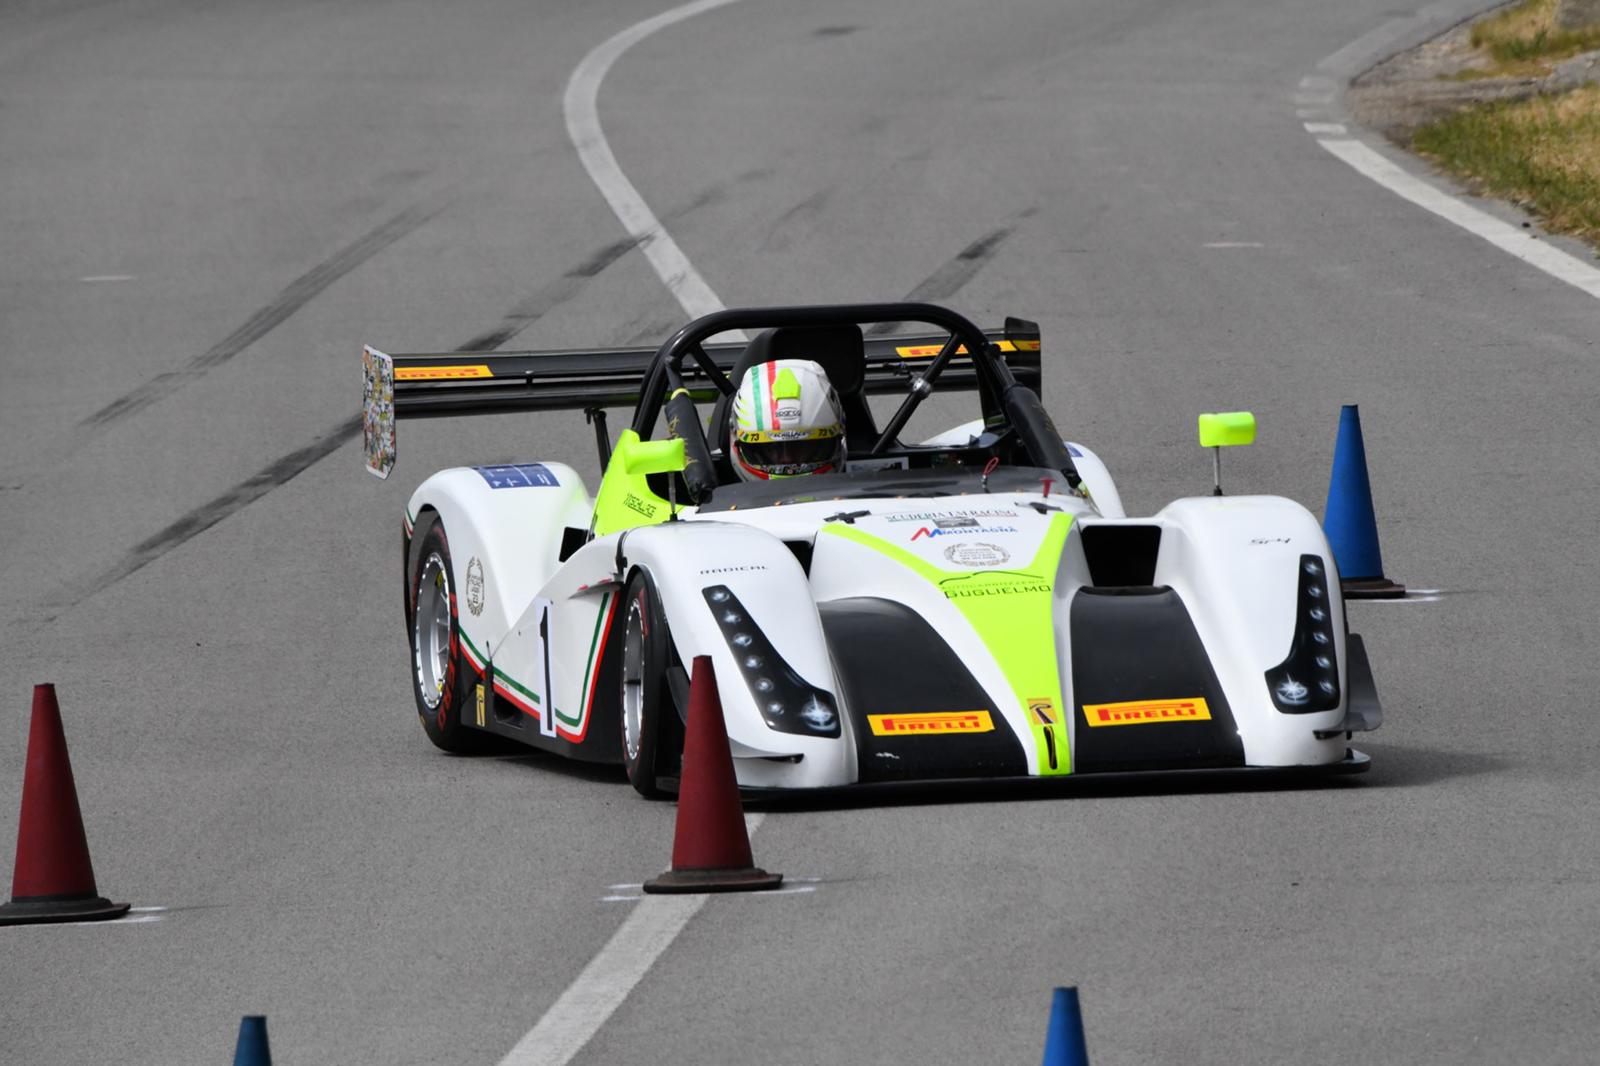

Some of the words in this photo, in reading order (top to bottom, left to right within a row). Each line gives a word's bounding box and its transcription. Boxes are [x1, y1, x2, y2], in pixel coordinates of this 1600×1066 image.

[750, 433, 760, 442] 73
[700, 565, 768, 575] RADICAL
[944, 584, 1051, 599] GUGLIELMO
[540, 606, 553, 731] 1
[1097, 703, 1197, 721] PIRELLI
[881, 715, 981, 731] PIRELLI
